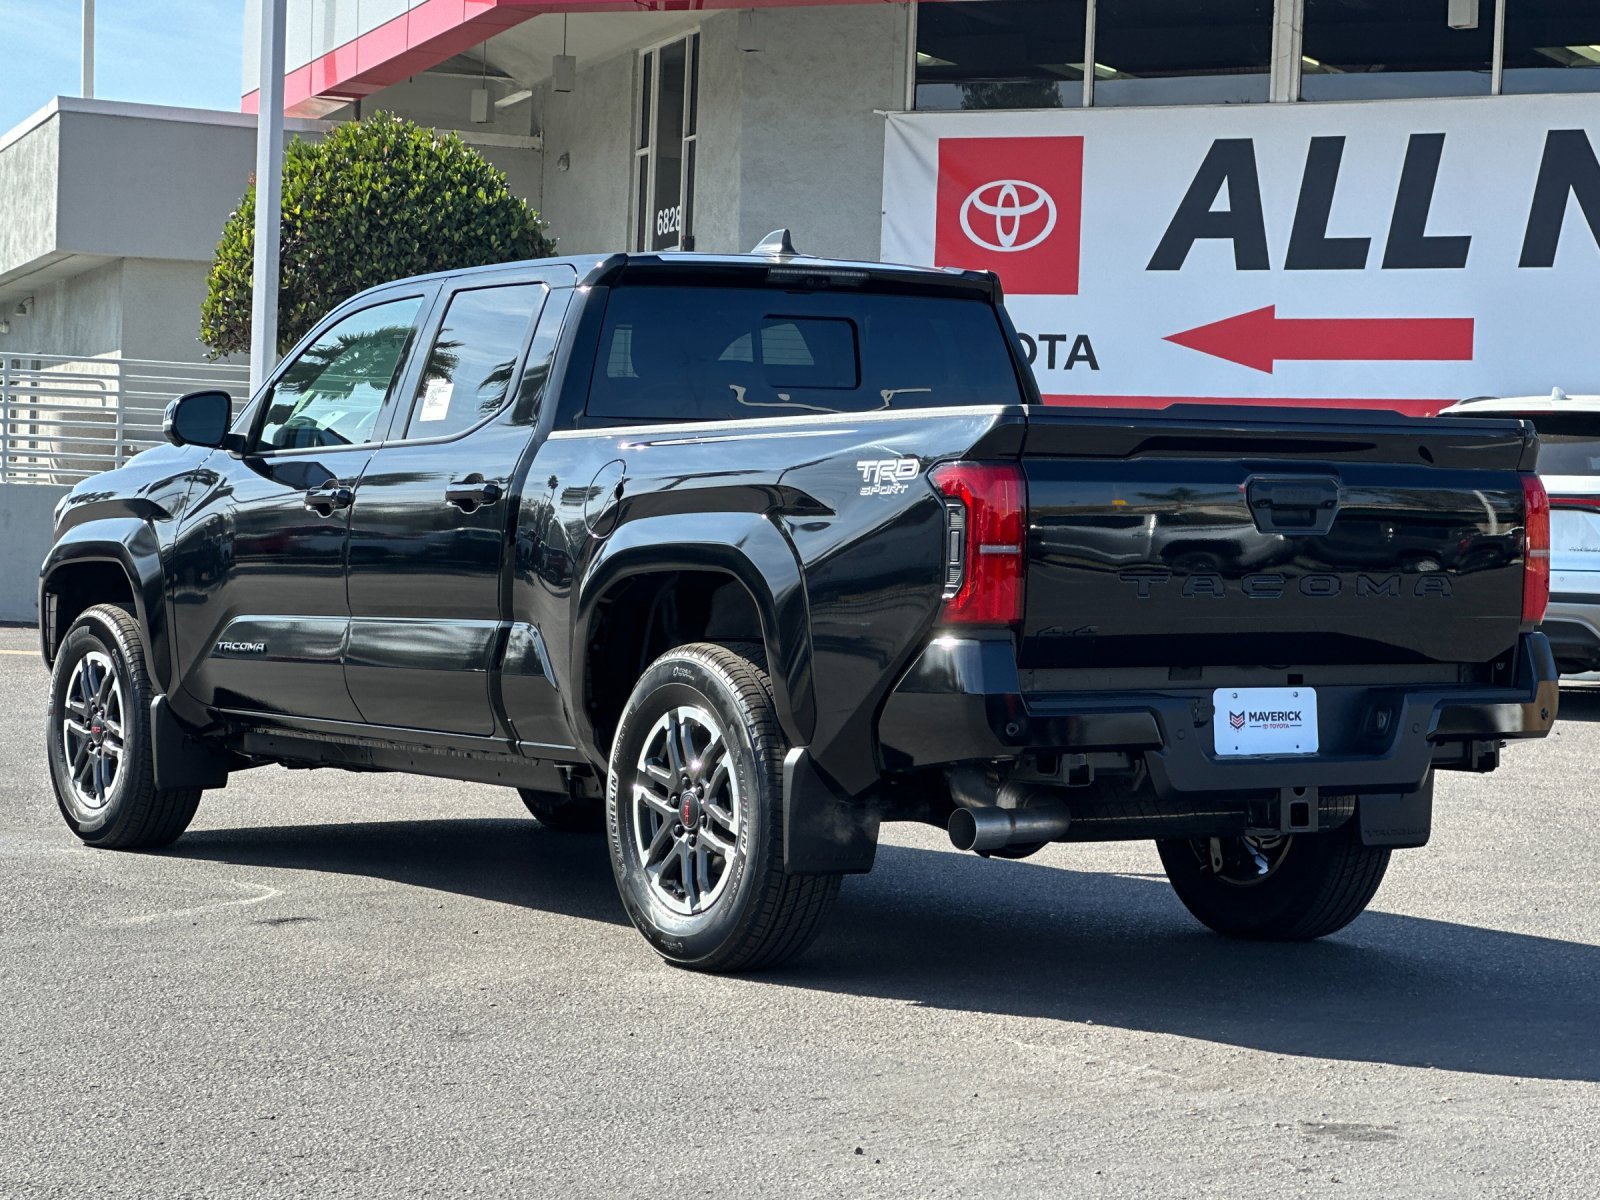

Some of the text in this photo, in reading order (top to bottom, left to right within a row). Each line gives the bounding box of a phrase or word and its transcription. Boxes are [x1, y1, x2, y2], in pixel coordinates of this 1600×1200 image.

[1145, 132, 1472, 270] ALL
[657, 205, 680, 236] 6828
[857, 459, 920, 484] TRD
[860, 484, 908, 496] SPORT
[1120, 573, 1452, 598] TACOMA
[217, 641, 264, 652] TACOMA
[1248, 711, 1302, 722] MAVERICK
[608, 774, 622, 854] MICHELIN
